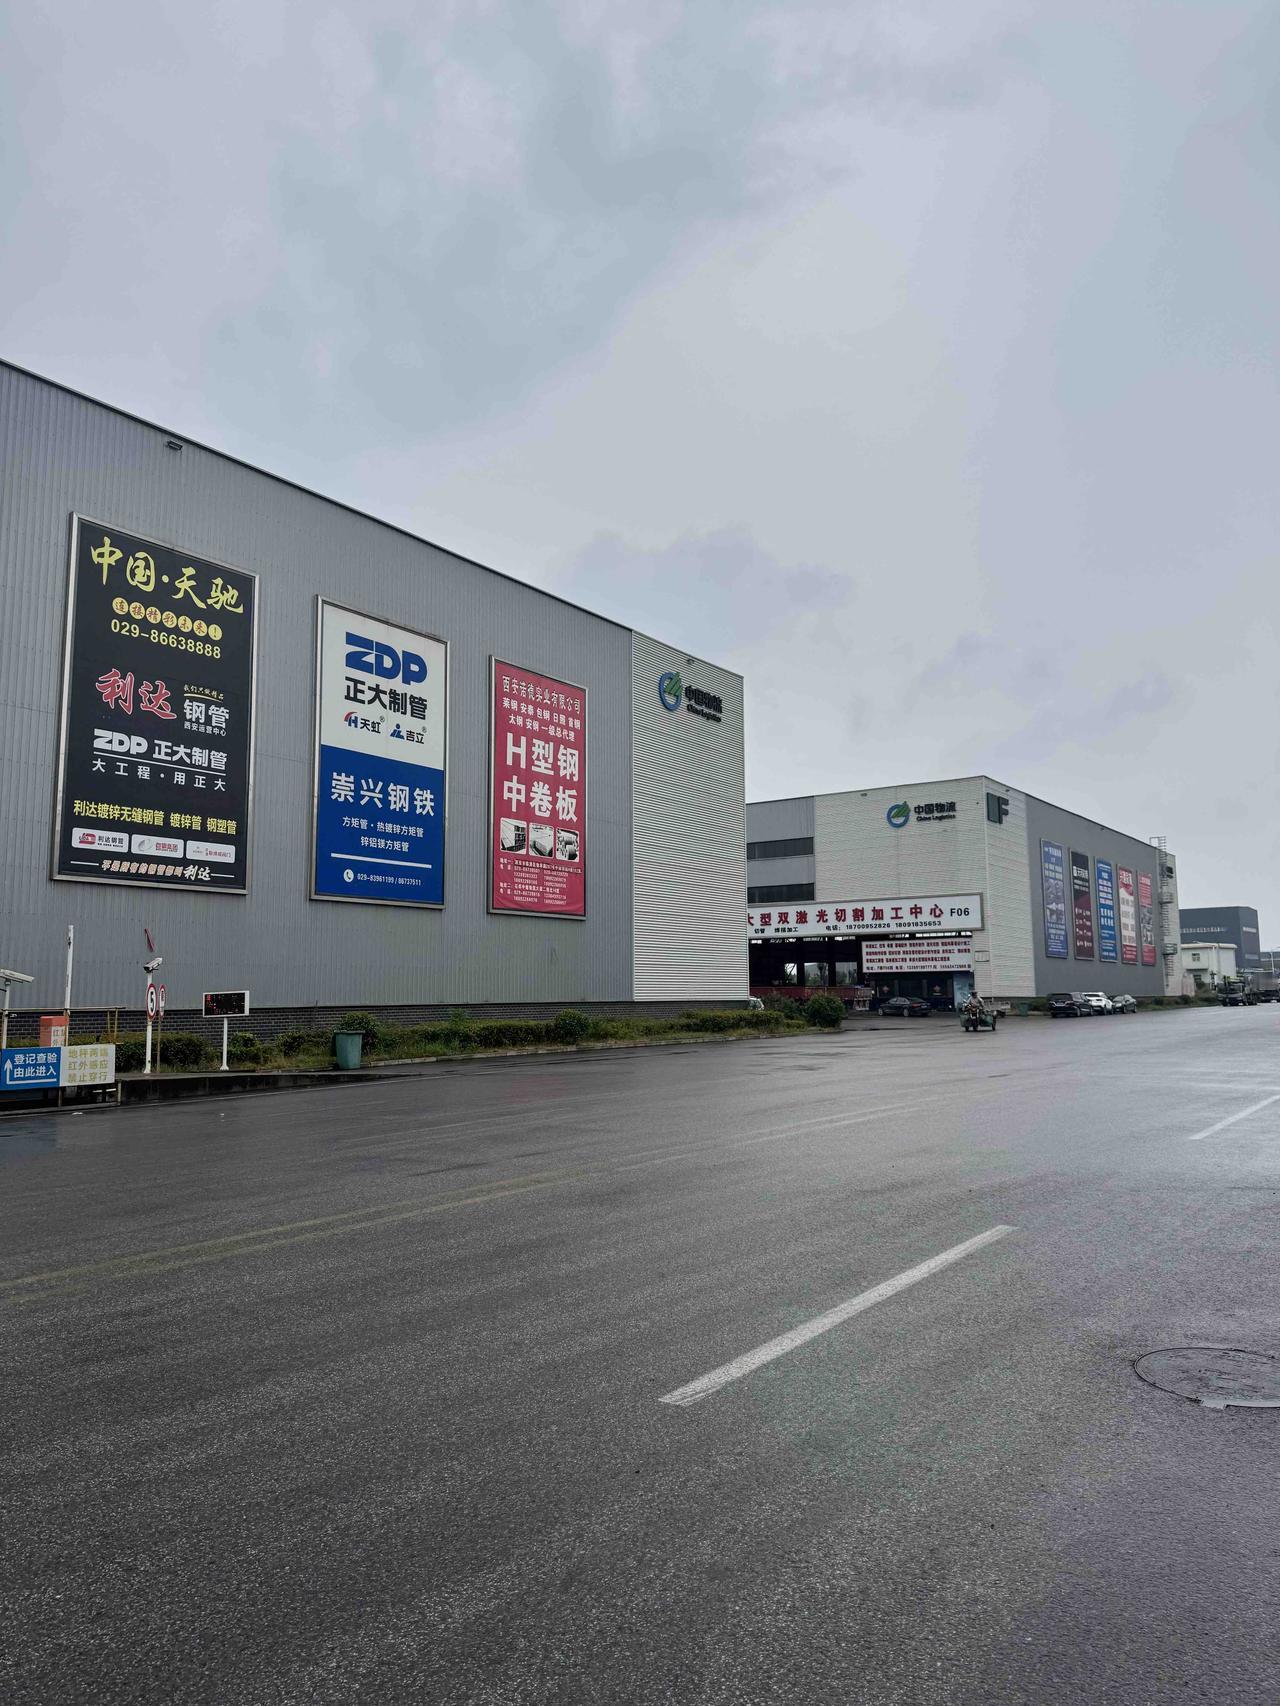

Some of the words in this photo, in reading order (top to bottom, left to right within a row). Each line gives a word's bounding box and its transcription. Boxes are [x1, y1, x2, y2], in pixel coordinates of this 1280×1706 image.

[90, 536, 244, 614] 中国·天驰
[111, 619, 221, 659] 029-86638888
[345, 631, 428, 685] ZDP
[96, 668, 177, 720] 利达
[183, 699, 230, 729] 钢管
[344, 676, 428, 720] 正大制管
[93, 728, 148, 755] ZDP
[152, 739, 228, 770] 正大制管
[184, 721, 227, 736] 西安运营中心
[506, 732, 579, 782] H型钢
[331, 772, 435, 817] 崇兴钢铁
[503, 775, 578, 821] 中卷板
[914, 801, 957, 815] 中国物流
[74, 800, 165, 826] 利达镀锌无缝钢管
[169, 812, 202, 831] 镀锌管
[206, 817, 237, 835] 钢塑管
[950, 907, 970, 917] F06
[14, 1053, 57, 1065] 登记查验
[14, 1066, 57, 1078] 由此进入
